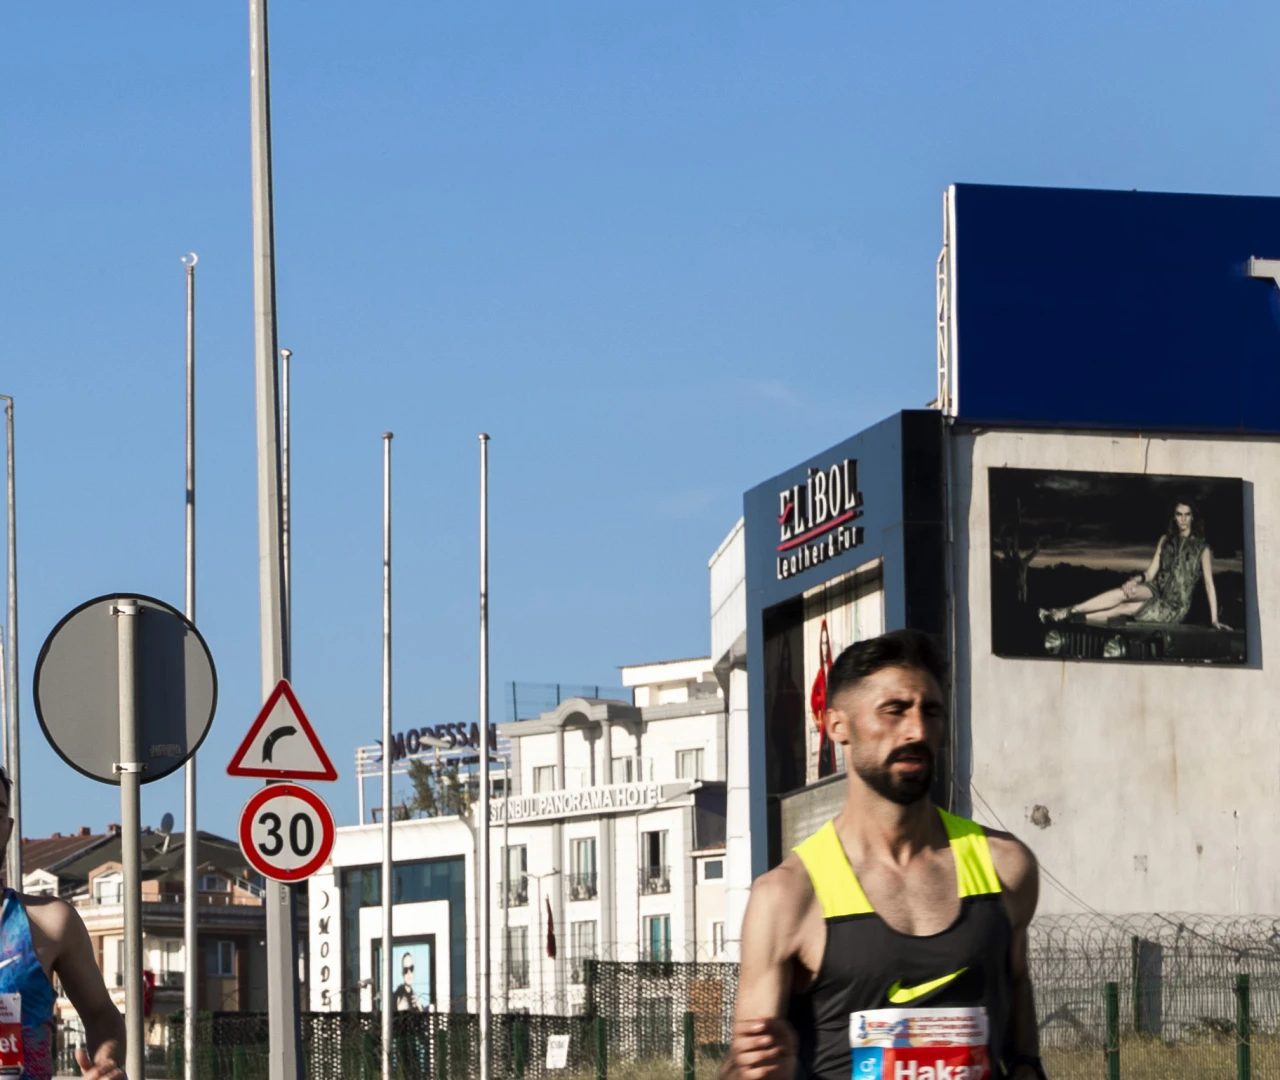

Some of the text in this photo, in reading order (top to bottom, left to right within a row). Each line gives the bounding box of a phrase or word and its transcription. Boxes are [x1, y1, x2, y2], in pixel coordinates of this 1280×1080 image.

[778, 458, 856, 542] ELİBOL
[776, 525, 857, 580] Leather & Fur
[489, 785, 666, 821] STNBUL PANORAMA HOTEL
[258, 811, 314, 857] 30
